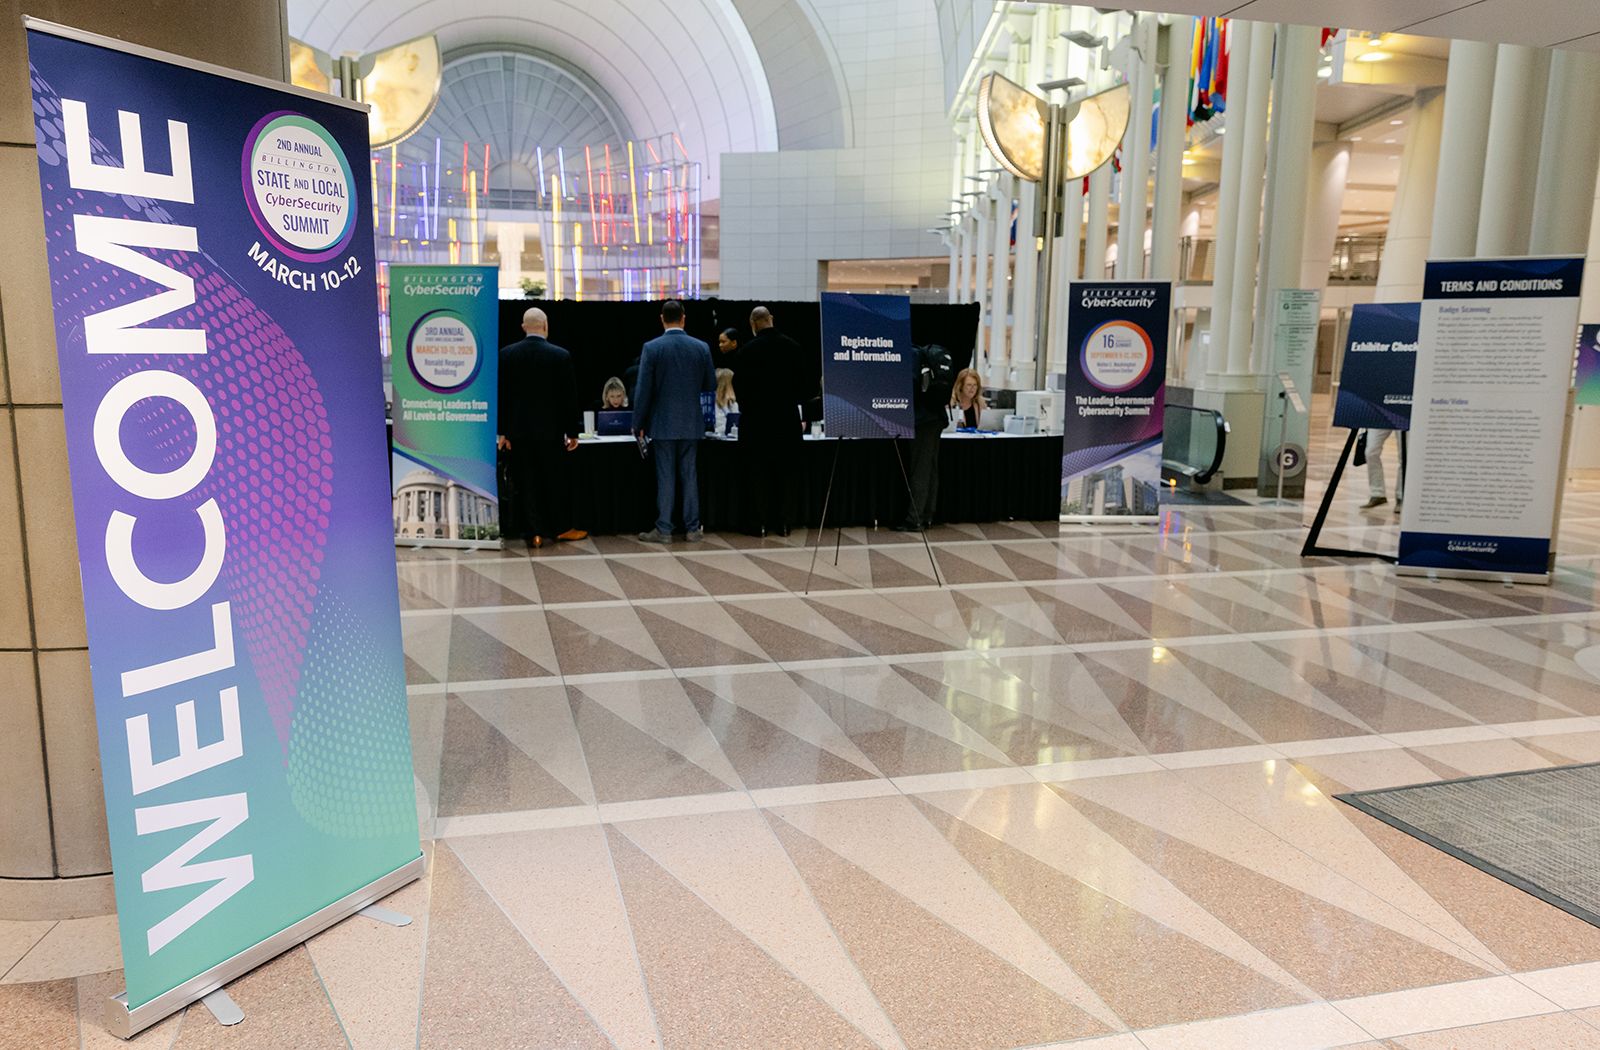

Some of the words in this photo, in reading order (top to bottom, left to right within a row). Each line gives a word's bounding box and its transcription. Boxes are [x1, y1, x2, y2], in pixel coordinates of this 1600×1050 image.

[276, 138, 292, 152] 2ND
[293, 141, 322, 157] ANNUAL
[261, 155, 338, 174] BILLINGTON
[257, 169, 290, 190] STATE
[293, 178, 309, 191] AND
[312, 178, 345, 199] LOCAL
[265, 192, 342, 215] CyberSecurity
[282, 214, 329, 235] SUMMIT
[247, 241, 316, 292] MARCH
[403, 275, 484, 283] BILLINGTON
[1440, 280, 1475, 293] TERMS
[1475, 280, 1498, 292] AND
[1499, 278, 1564, 291] CONDITIONS
[403, 284, 482, 297] CyberSecurity
[1082, 289, 1156, 297] BILLINGTON
[1081, 297, 1154, 309] CyberSecurity
[425, 327, 438, 336] 3RD
[439, 327, 464, 336] ANNUAL
[840, 335, 894, 349] Registration
[1350, 341, 1390, 352] Exhibitor
[416, 345, 440, 354] MARCH
[833, 350, 850, 361] and
[851, 350, 902, 362] Information
[402, 398, 443, 411] Connecting
[443, 399, 471, 410] Leaders
[472, 399, 488, 410] from
[1075, 396, 1088, 405] The
[1088, 396, 1114, 407] Leading
[1114, 396, 1155, 405] Government
[403, 411, 413, 421] All
[414, 411, 436, 421] Levels
[437, 411, 445, 421] of
[445, 412, 488, 422] Government
[1078, 406, 1124, 417] Cybersecurity
[1124, 406, 1150, 416] Summit
[1282, 453, 1294, 466] G
[62, 97, 255, 956] WELCOME
